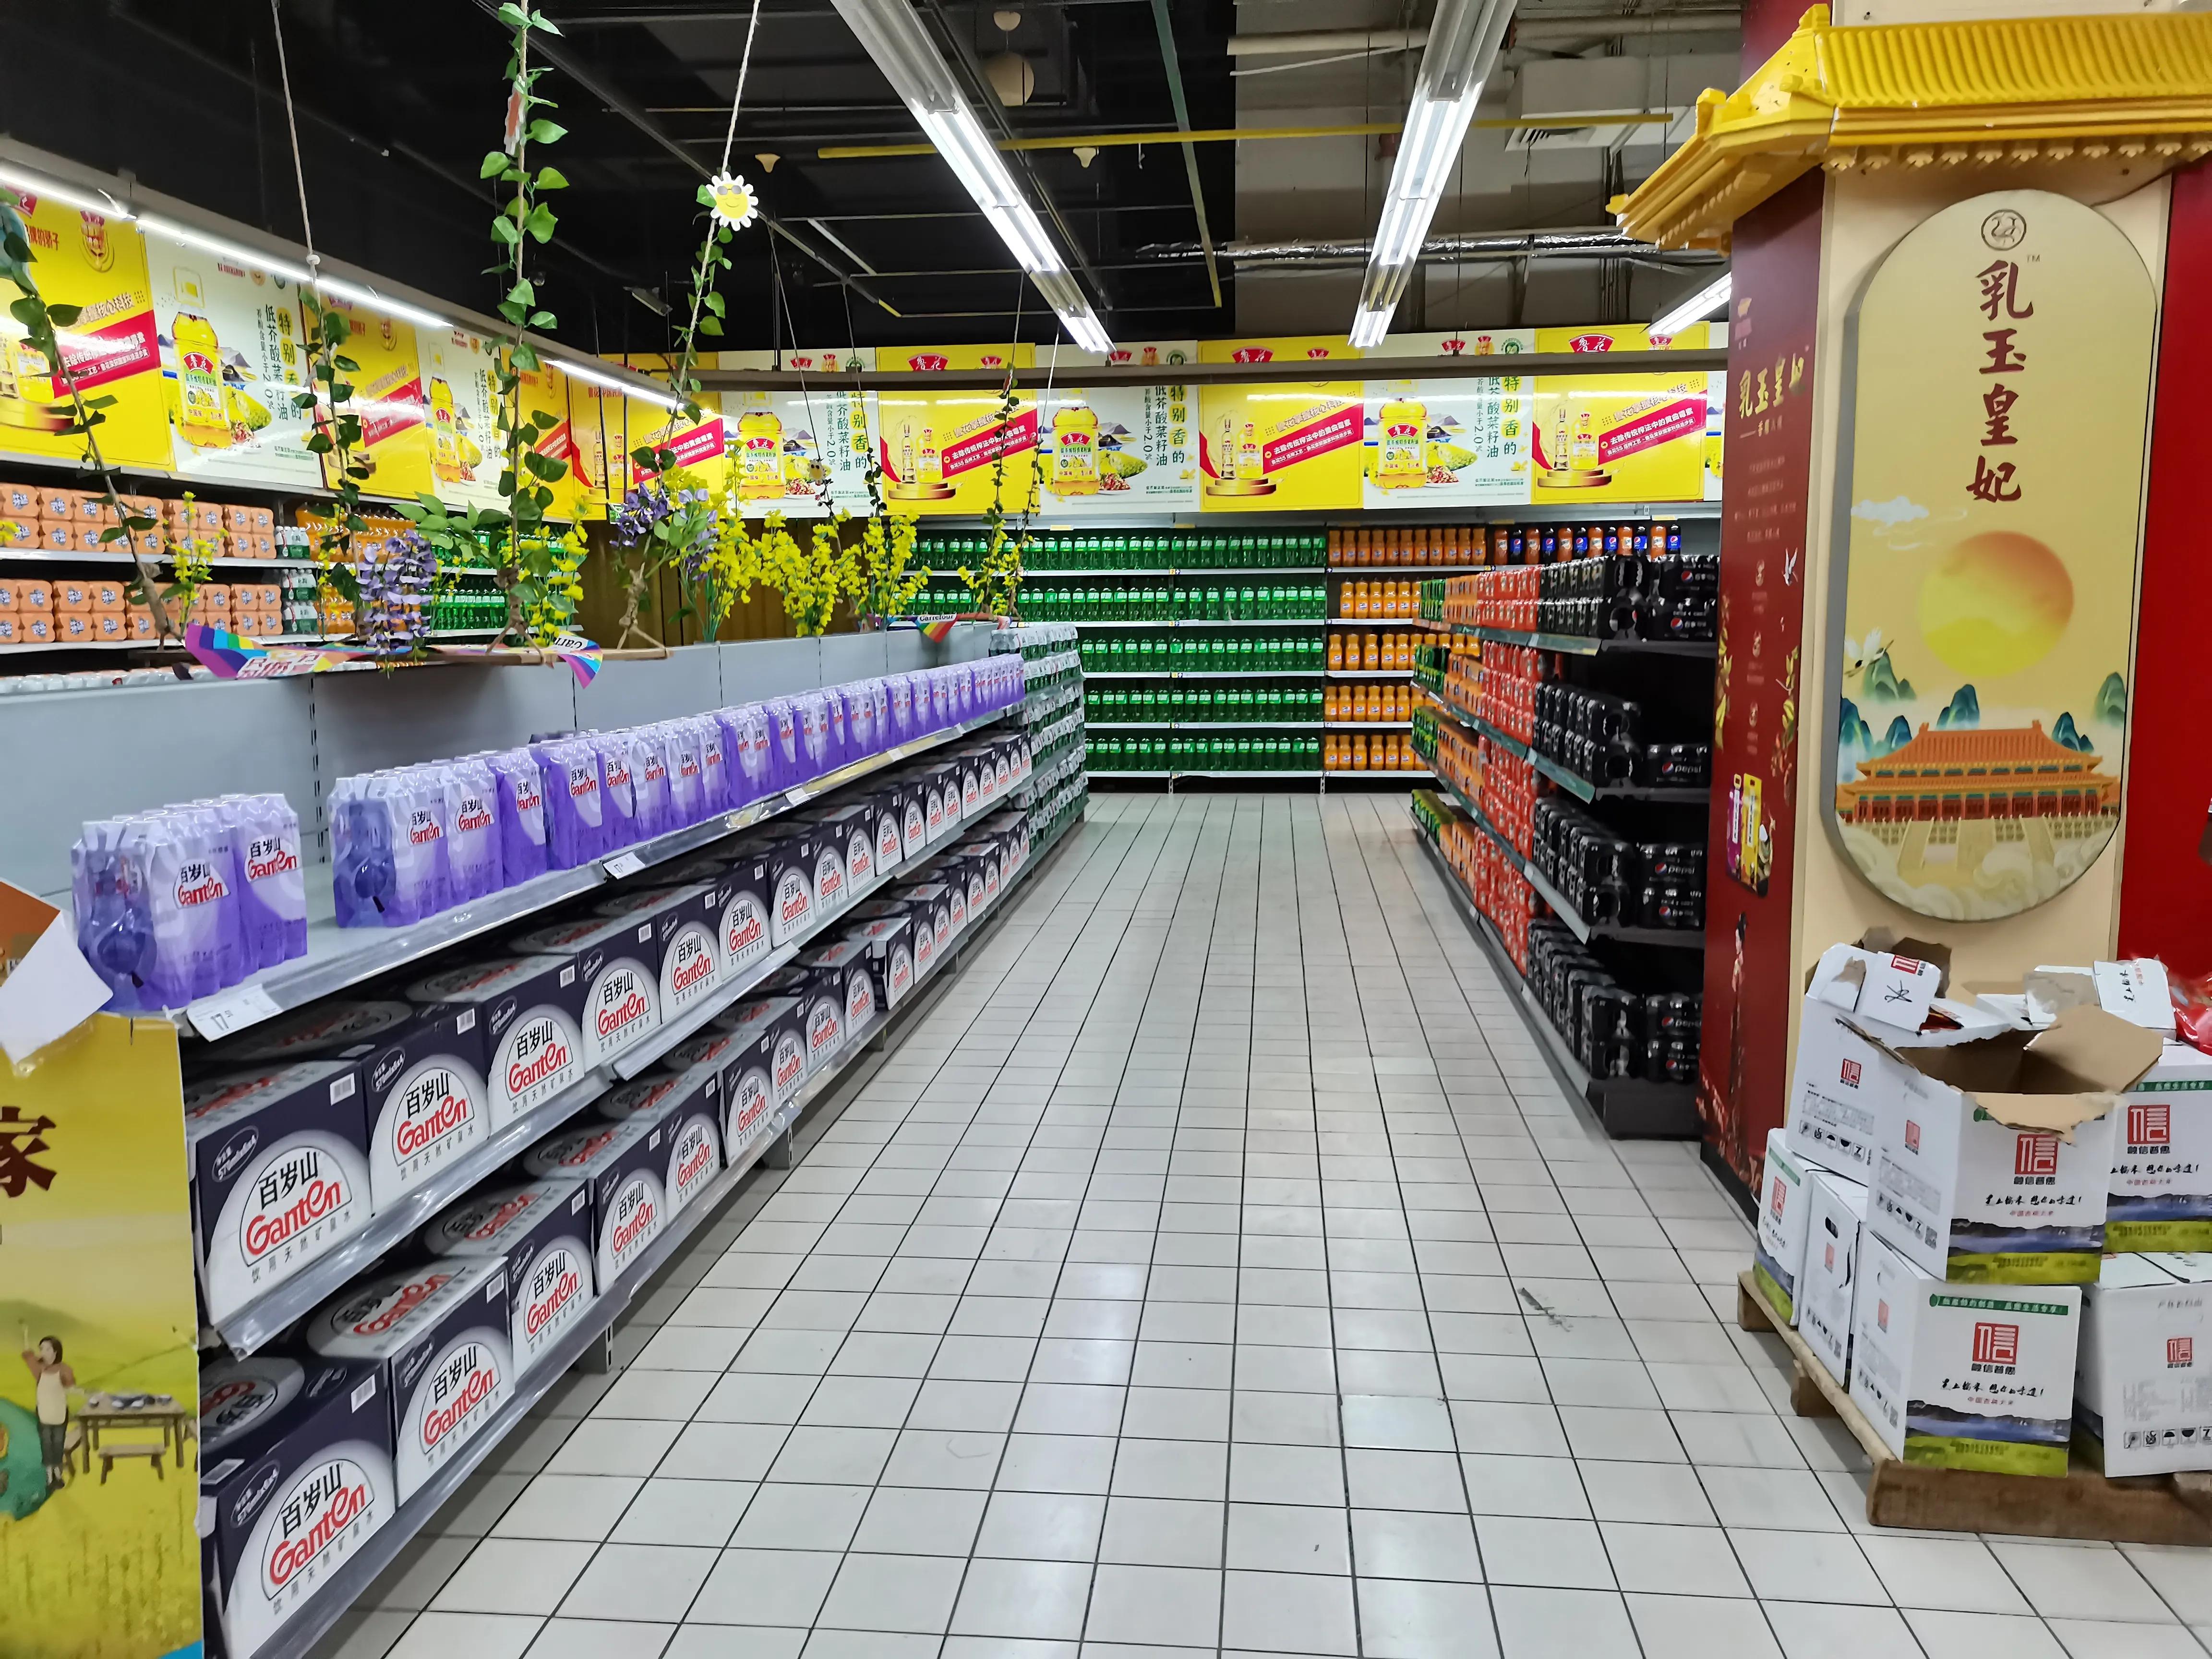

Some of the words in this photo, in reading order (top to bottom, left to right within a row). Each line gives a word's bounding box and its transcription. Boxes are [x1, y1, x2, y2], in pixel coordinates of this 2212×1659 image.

[1576, 337, 1606, 352] 鲁花
[1966, 260, 2034, 504] 乳玉皇妃
[1155, 385, 1167, 467] 低芥酸菜籽油
[1170, 385, 1186, 464] 特别香的
[732, 902, 753, 927] 百岁山
[678, 934, 701, 964] 百岁山
[603, 972, 634, 1006] 百岁山
[516, 1021, 553, 1060] 百岁山
[406, 1072, 450, 1119] 百岁山
[741, 1078, 759, 1107] 百岁山
[682, 1126, 702, 1160] 百岁山
[259, 1151, 318, 1211] 百岁山
[619, 1182, 644, 1223] 百岁山
[533, 1251, 566, 1300] 百岁山
[433, 1346, 477, 1406] 百岁山
[281, 1463, 342, 1540] 百岁山
